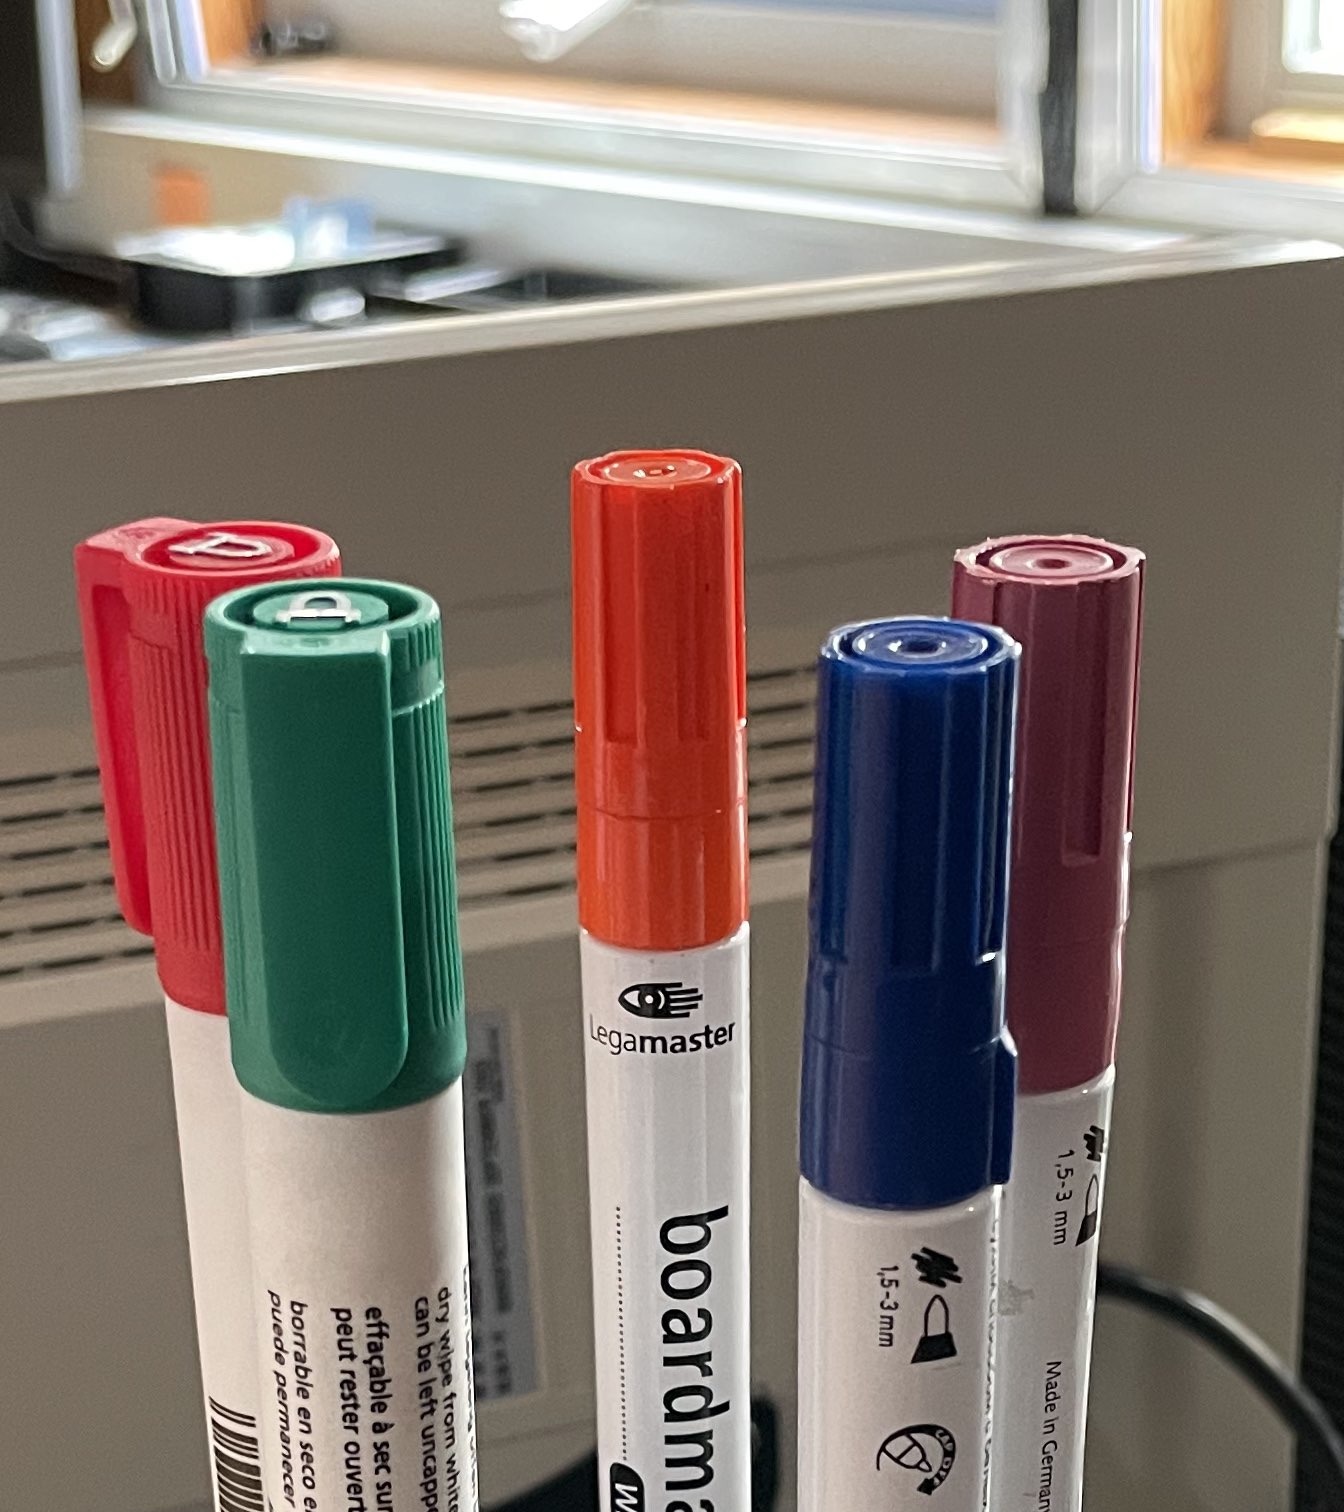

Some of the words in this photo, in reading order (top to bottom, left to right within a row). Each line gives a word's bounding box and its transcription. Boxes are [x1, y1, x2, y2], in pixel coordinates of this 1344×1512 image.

[588, 1013, 736, 1056] Legamaster
[1054, 1149, 1074, 1202] 1,5-3
[1053, 1211, 1068, 1246] mm
[435, 1287, 452, 1324] dry
[877, 1265, 899, 1311] 1,5-3
[268, 1290, 286, 1366] puede
[331, 1307, 358, 1361] peut
[414, 1297, 434, 1336] can
[878, 1316, 895, 1347] mm
[289, 1300, 316, 1399] borrable
[363, 1307, 393, 1414] effaçable
[417, 1345, 435, 1372] be
[438, 1330, 455, 1388] wipe
[339, 1369, 365, 1432] rester
[419, 1380, 438, 1419] left
[1044, 1361, 1061, 1413] Made
[273, 1371, 297, 1508] permanecer
[298, 1407, 315, 1434] en
[372, 1422, 395, 1434] à
[443, 1393, 459, 1445] from
[1043, 1419, 1058, 1434] in
[299, 1441, 319, 1489] seco
[373, 1442, 390, 1475] sec
[376, 1482, 394, 1512] sur
